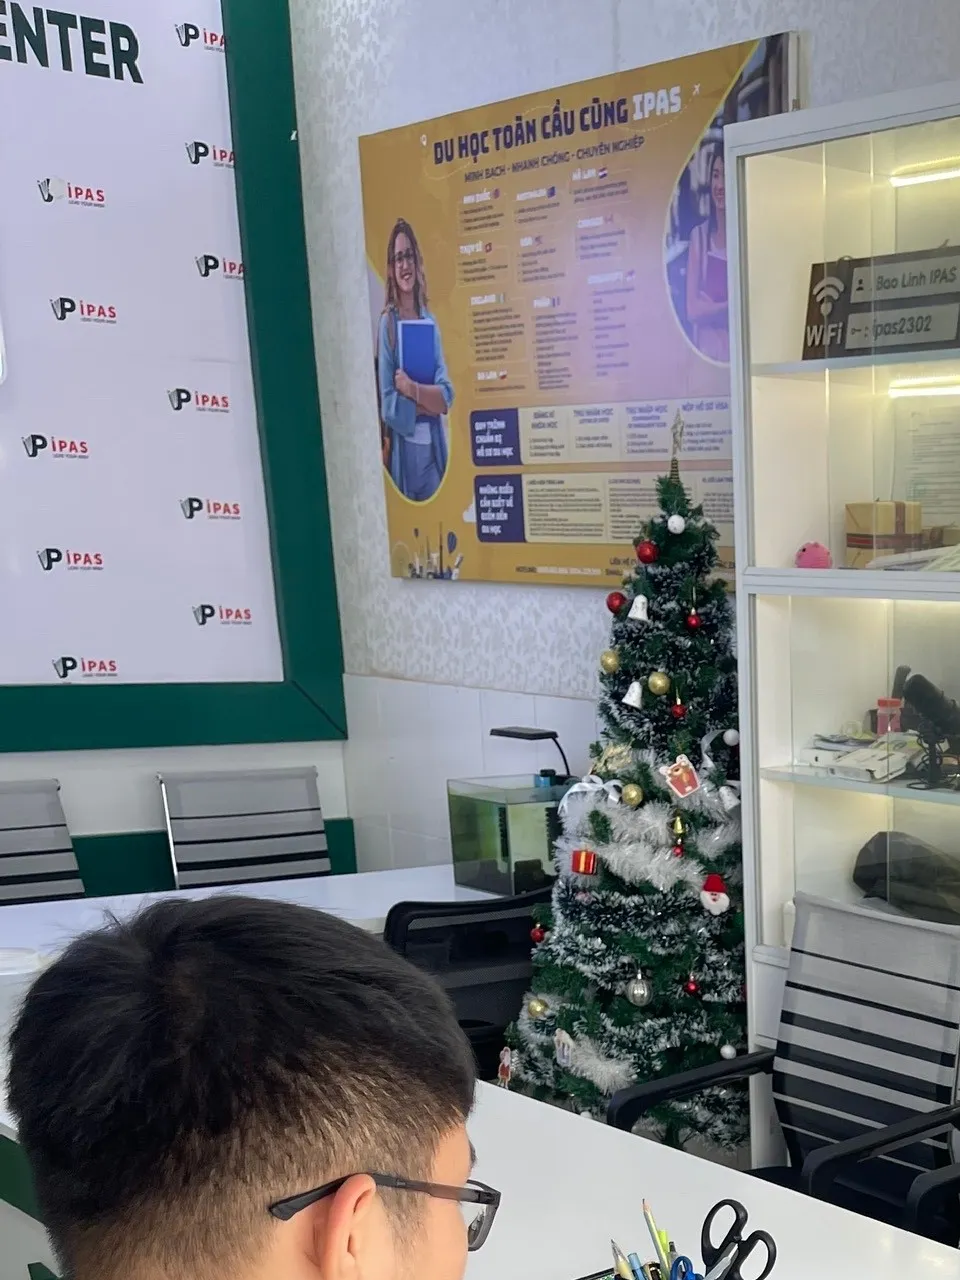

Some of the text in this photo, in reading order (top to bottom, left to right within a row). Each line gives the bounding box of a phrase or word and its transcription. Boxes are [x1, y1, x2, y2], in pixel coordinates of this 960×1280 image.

[434, 86, 681, 164] DU HỌC TOÀN CẦU CÙNG IPAS
[876, 267, 957, 291] Bao Linh IPAS
